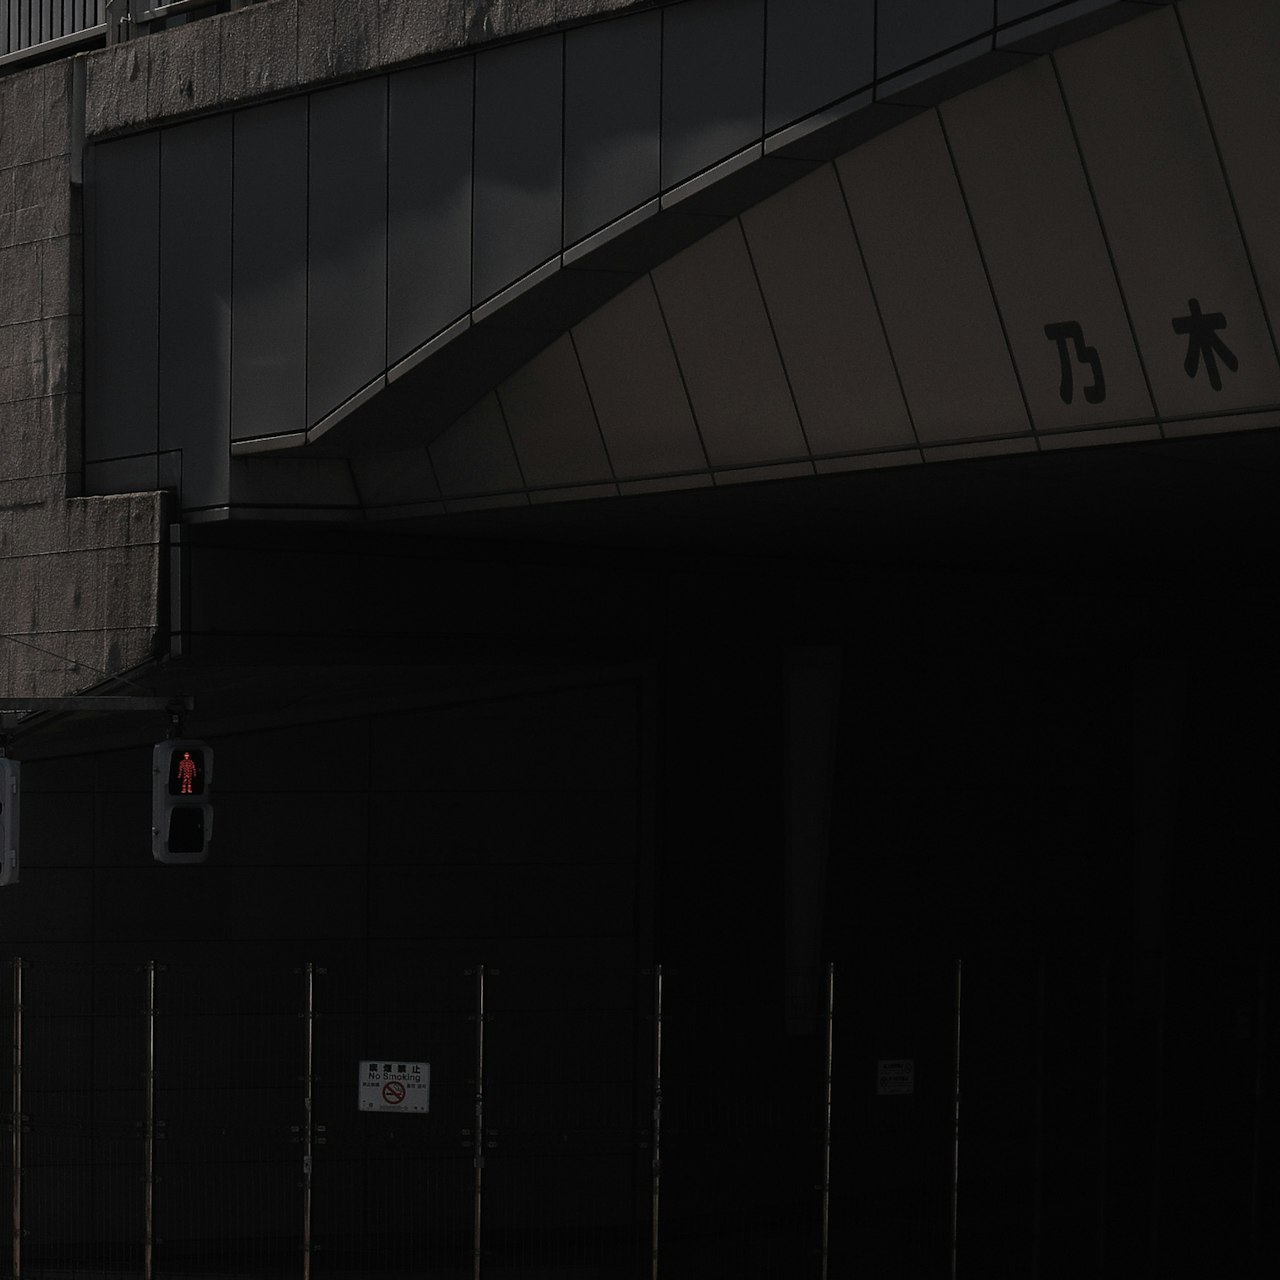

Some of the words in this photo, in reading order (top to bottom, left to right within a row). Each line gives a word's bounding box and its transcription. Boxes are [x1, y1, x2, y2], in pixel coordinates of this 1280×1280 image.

[1044, 298, 1239, 405] 乃木
[368, 1072, 381, 1080] No
[383, 1073, 421, 1083] Smoking
